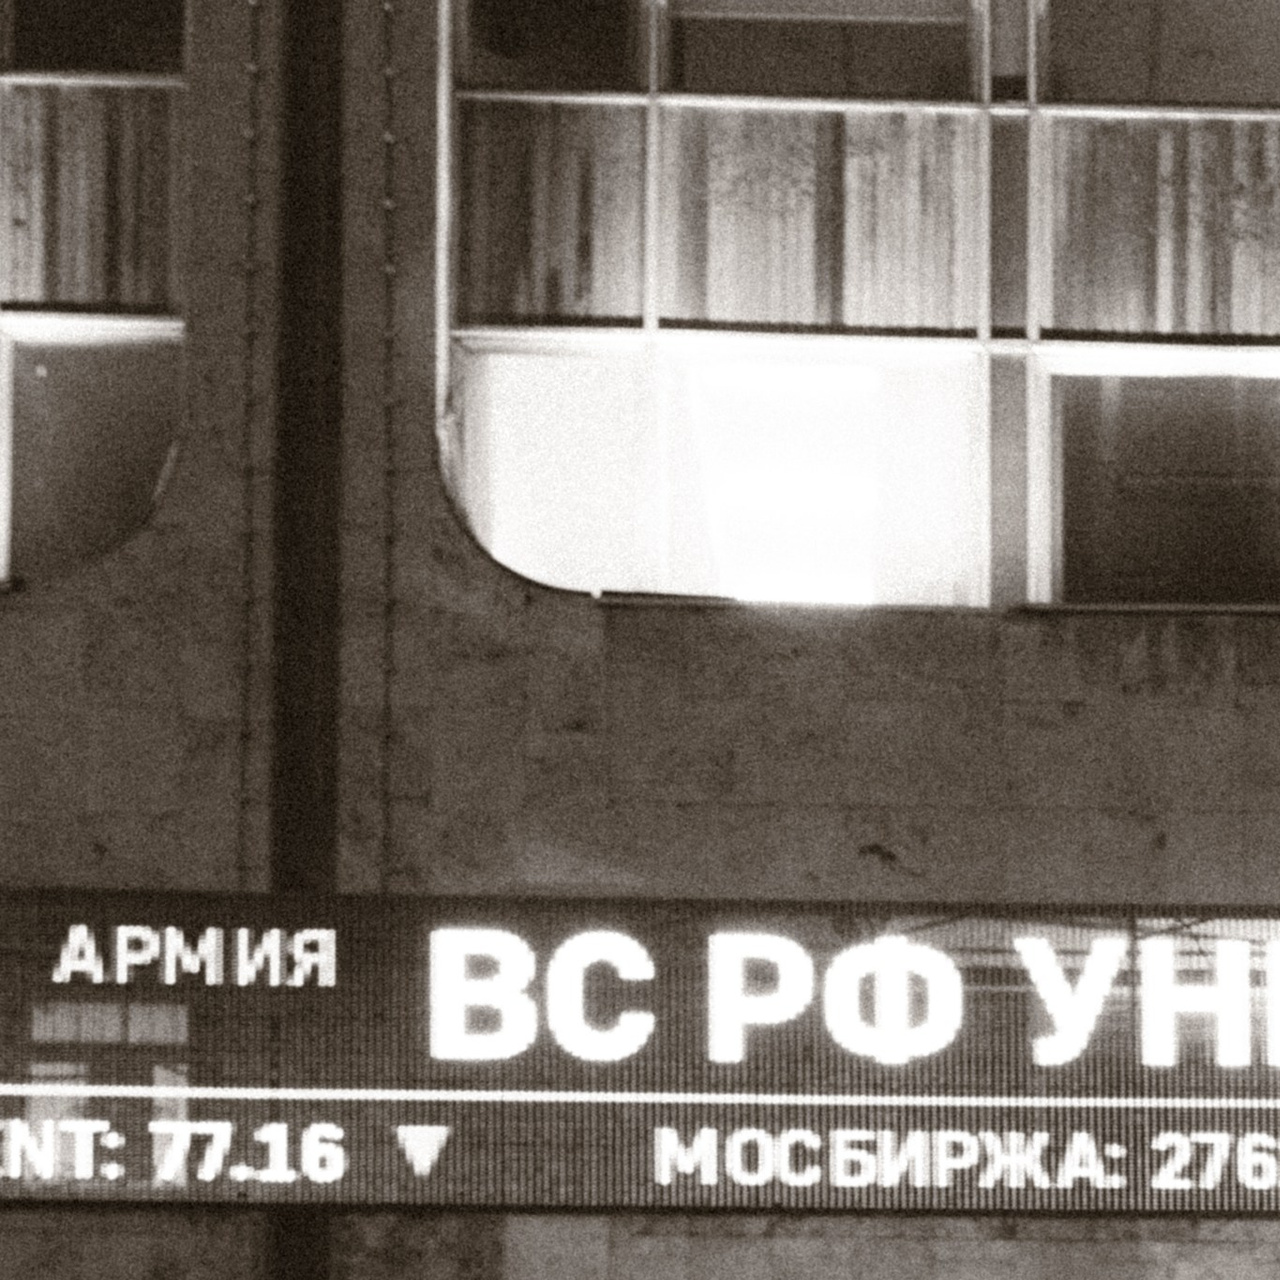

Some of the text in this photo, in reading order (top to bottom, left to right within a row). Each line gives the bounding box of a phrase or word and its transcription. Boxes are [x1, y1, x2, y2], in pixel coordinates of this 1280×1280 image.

[53, 925, 337, 988] АРМИЯ
[429, 925, 656, 1063] ВС
[707, 930, 964, 1067] РФ
[0, 1118, 347, 1184] NT: 77.16
[653, 1125, 1128, 1191] МОСБИРЖА:
